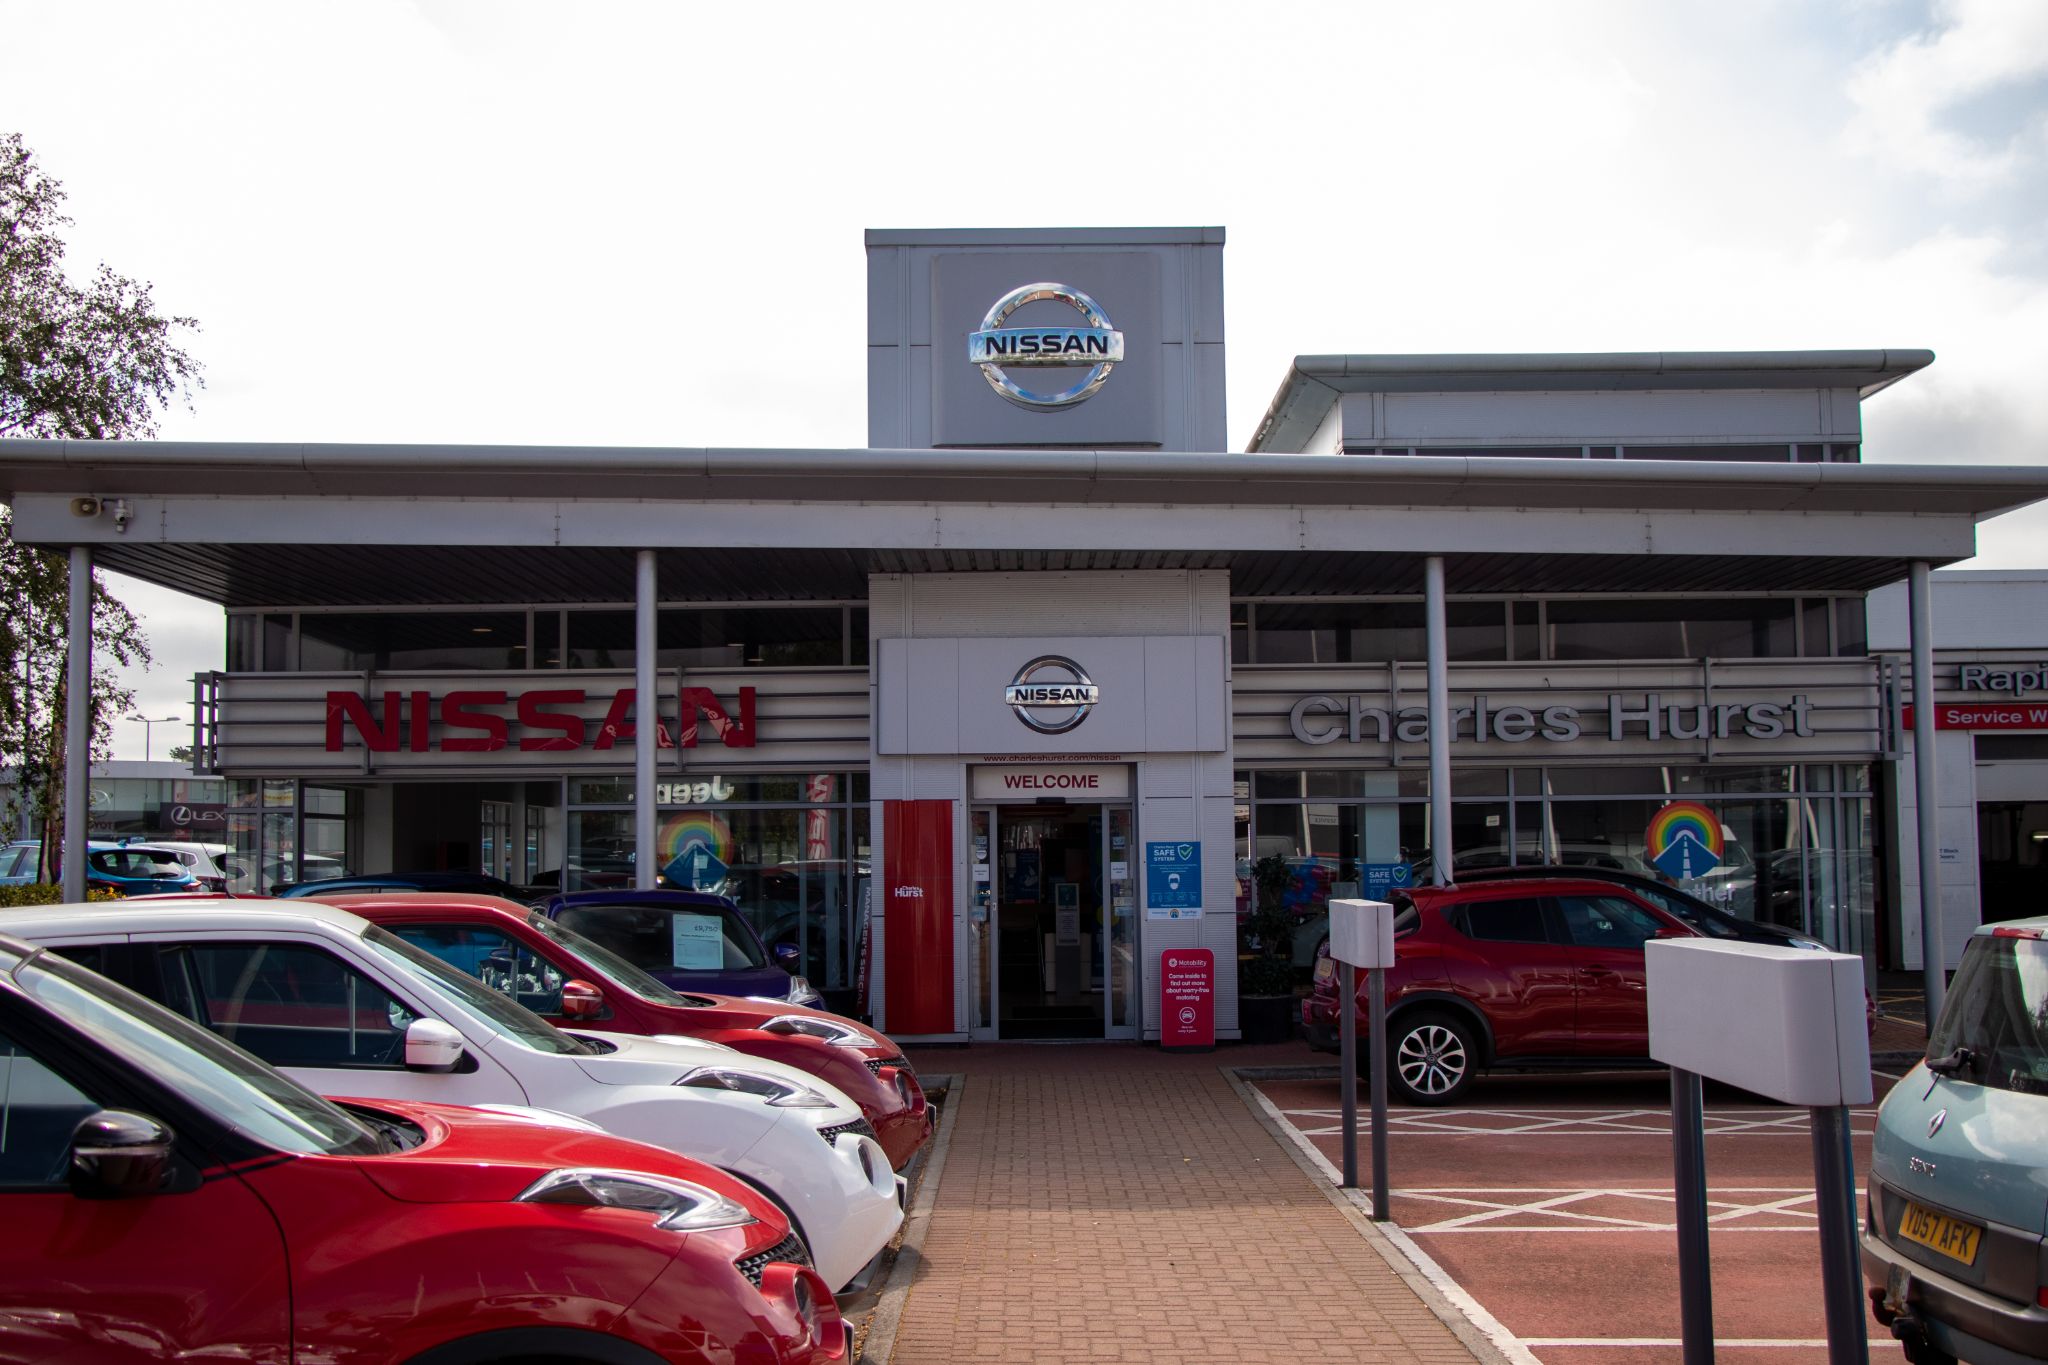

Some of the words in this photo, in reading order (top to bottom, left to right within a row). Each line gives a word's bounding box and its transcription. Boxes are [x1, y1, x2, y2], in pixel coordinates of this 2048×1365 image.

[985, 335, 1109, 355] NISSAN
[1015, 688, 1090, 701] NISSAN
[326, 686, 756, 752] NISSAN
[1289, 694, 1582, 746] Charles
[1607, 692, 1816, 743] Hurst
[1946, 709, 2024, 724] Service
[983, 753, 1121, 762] www.charleshurst.com/nissan
[1004, 774, 1099, 789] WELCOME
[894, 886, 924, 897] Hurst
[860, 886, 872, 958] MANAGER'S
[857, 958, 867, 1008] SPECIAL
[1905, 1208, 1940, 1242] YD57
[1938, 1221, 1974, 1257] AFK
